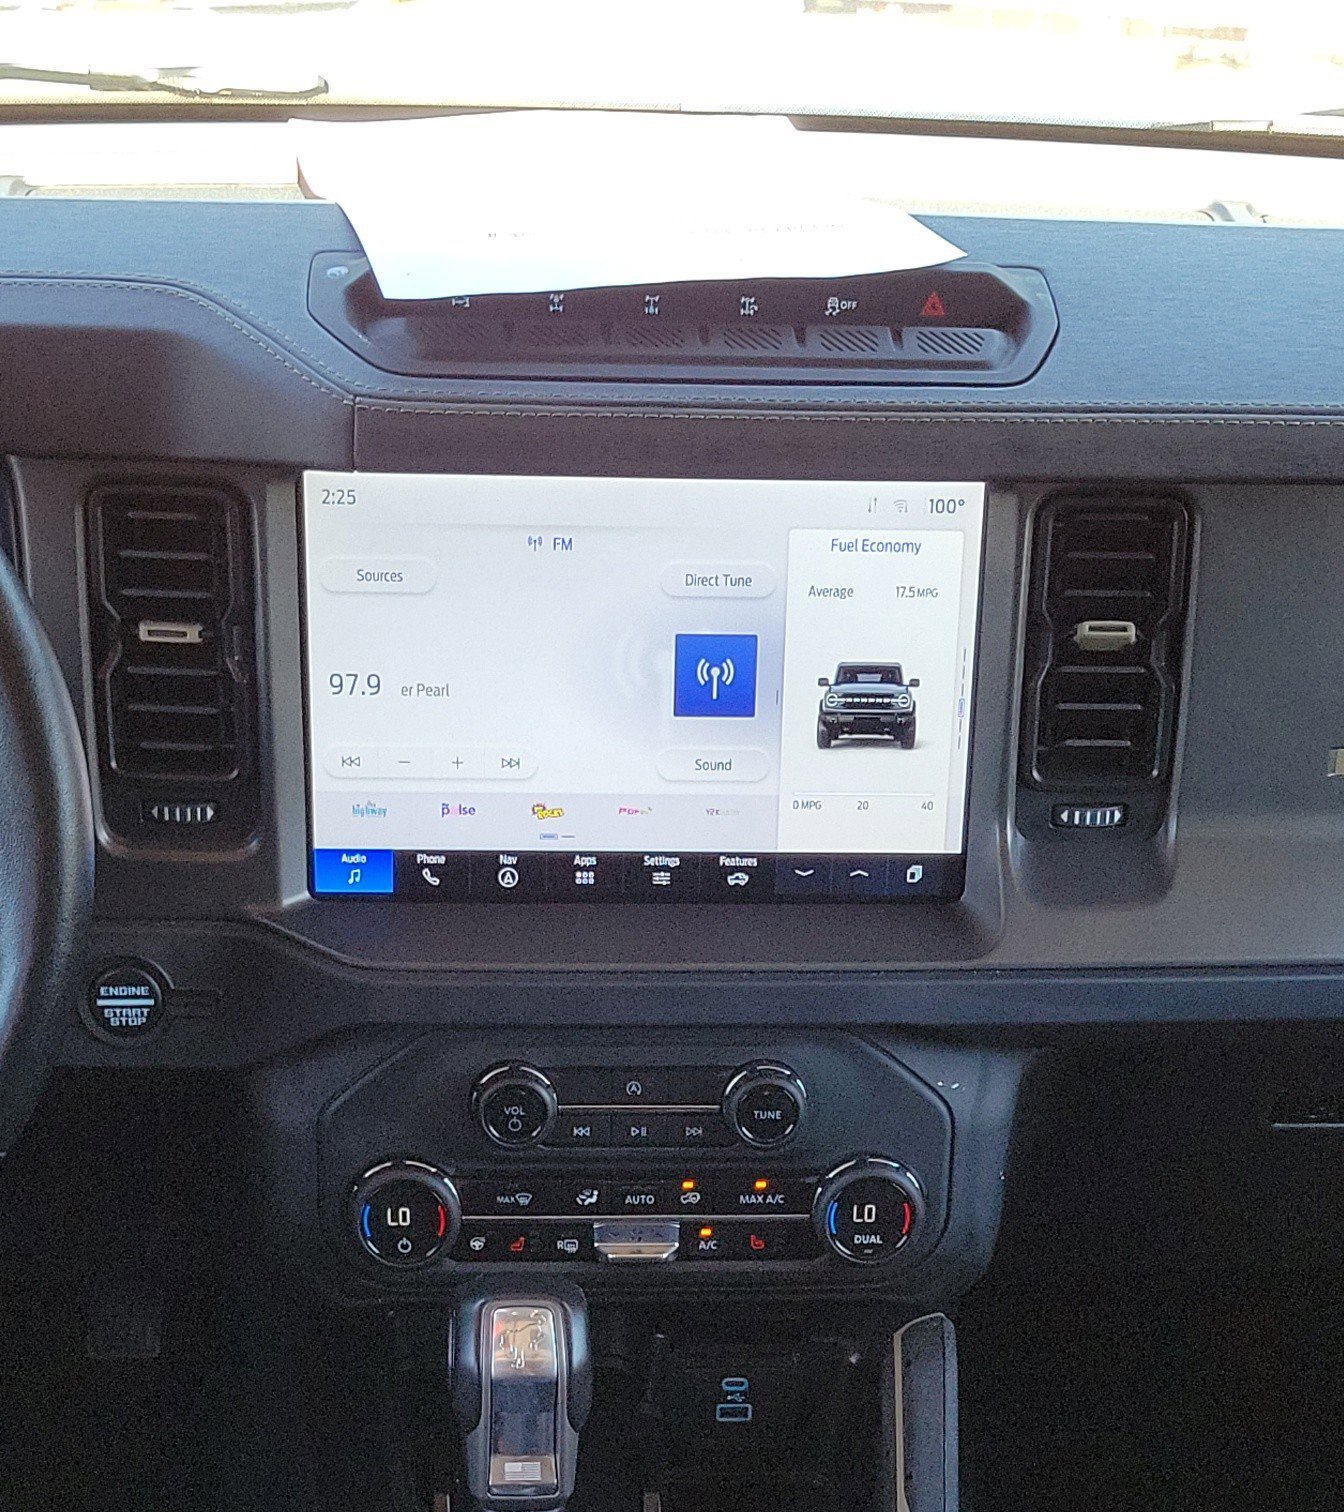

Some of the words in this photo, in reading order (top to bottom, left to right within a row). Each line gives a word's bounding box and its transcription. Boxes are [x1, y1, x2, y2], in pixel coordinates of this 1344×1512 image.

[839, 301, 858, 310] OFF
[321, 488, 357, 505] 2:25
[553, 537, 573, 551] FM
[831, 538, 859, 553] Fuel
[861, 538, 922, 556] Economy
[356, 568, 404, 583] Sources
[684, 573, 720, 588] Direct
[723, 573, 753, 588] Tune
[808, 585, 854, 600] Average
[329, 673, 382, 696] 97.9
[400, 685, 414, 697] er
[416, 683, 450, 697] Pearl
[694, 758, 733, 772] Sound
[856, 801, 869, 811] 20
[921, 801, 934, 811] 40
[341, 853, 367, 864] Audio
[416, 853, 446, 865] Phone
[499, 854, 518, 865] Nav
[573, 855, 597, 867] Apps
[644, 855, 680, 868] Settings
[719, 855, 758, 867] Features
[99, 986, 150, 996] ENGINE
[103, 1008, 150, 1018] START
[110, 1017, 147, 1027] STOP
[504, 1106, 526, 1117] VOL
[753, 1110, 783, 1120] TUNE
[496, 1195, 516, 1204] MAX
[624, 1194, 655, 1205] AUTO
[739, 1194, 764, 1205] MAX
[765, 1194, 785, 1205] A/C
[699, 1240, 718, 1250] A/C
[854, 1234, 884, 1245] DUAL
